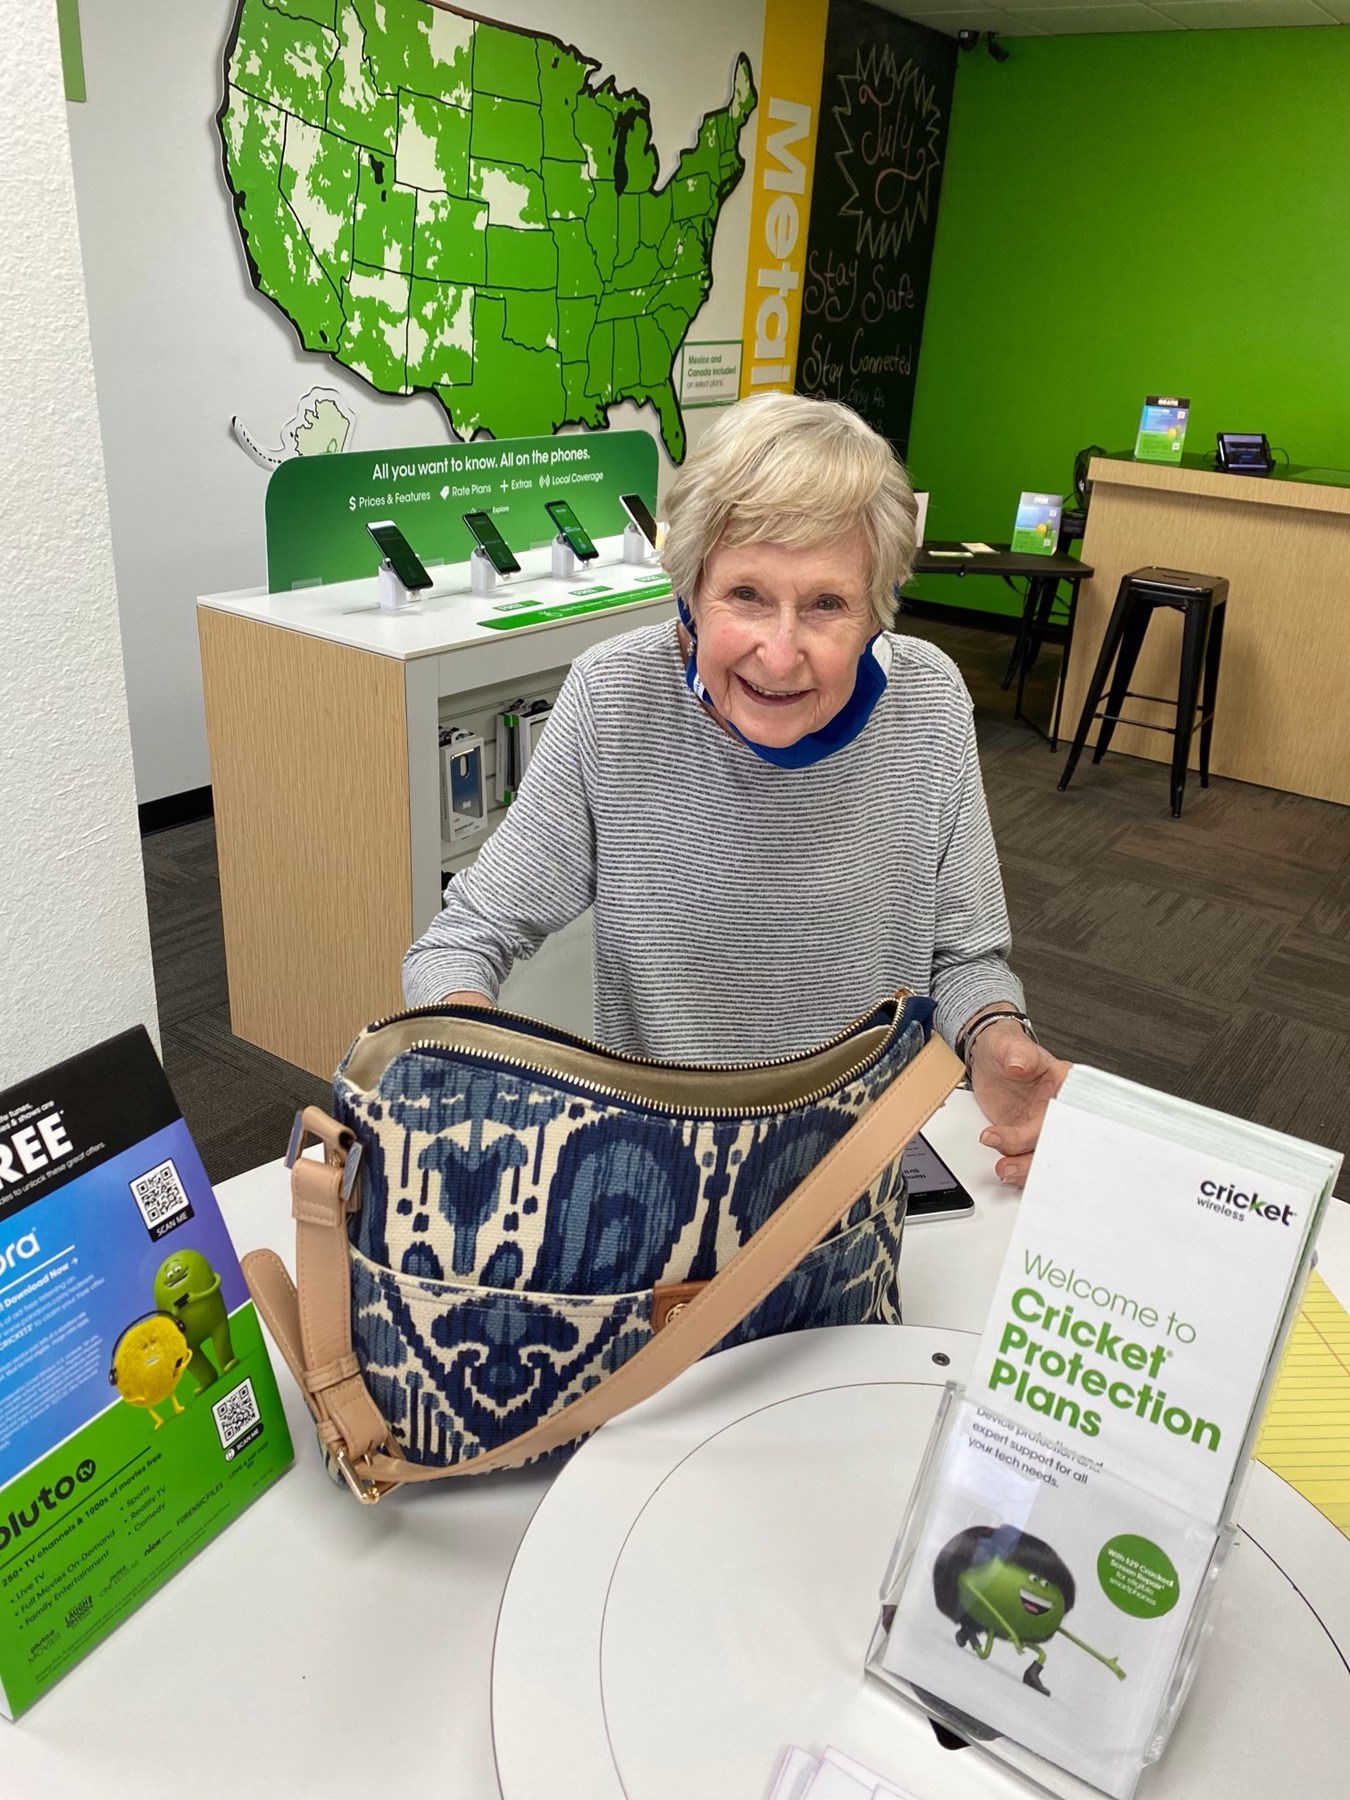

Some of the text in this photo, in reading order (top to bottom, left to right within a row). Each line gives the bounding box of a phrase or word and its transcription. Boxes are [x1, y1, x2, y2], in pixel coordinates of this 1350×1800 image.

[859, 83, 926, 214] July
[751, 97, 811, 396] Metai
[804, 248, 914, 323] Stay Safe
[688, 355, 722, 364] Mexico and
[688, 366, 736, 377] Canada included
[802, 328, 912, 401] Stay Connected
[695, 380, 709, 388] select
[873, 387, 885, 408] As
[373, 448, 590, 481] All you want to know. All on the phones.
[552, 471, 604, 485] Local Coverage
[359, 496, 385, 508] Prices
[387, 495, 393, 504] &
[395, 491, 430, 504] Features
[452, 483, 492, 497] Rate Plans
[511, 479, 532, 490] Extras
[18, 1106, 41, 1123] shows
[41, 1100, 55, 1111] are
[0, 1112, 74, 1190] REE
[13, 1188, 22, 1197] to
[22, 1175, 46, 1192] unlock
[46, 1162, 67, 1178] these
[66, 1151, 86, 1169] great
[1197, 1197, 1245, 1222] wireless
[1200, 1181, 1294, 1227] cricket
[156, 1211, 188, 1237] SCAN ME
[4, 1262, 70, 1308] Download Now
[1025, 1249, 1197, 1344] Welcome to
[988, 1358, 1102, 1438] Plans
[998, 1322, 1222, 1453] Protection
[236, 1428, 260, 1450] SCAN ME
[972, 1421, 1088, 1485] expert support for all
[968, 1436, 1059, 1488] your tech needs.
[127, 1485, 150, 1508] Sports
[130, 1484, 167, 1521] Reality TV
[1, 1453, 162, 1587] 250+ TV channels & 1000s of movies free
[134, 1502, 167, 1532] Comedy
[21, 1528, 116, 1614] Full Movies On-Demand
[1108, 1548, 1125, 1562] With
[15, 1571, 45, 1600] Live TV
[25, 1600, 53, 1627] Family
[54, 1550, 109, 1601] Entertainment
